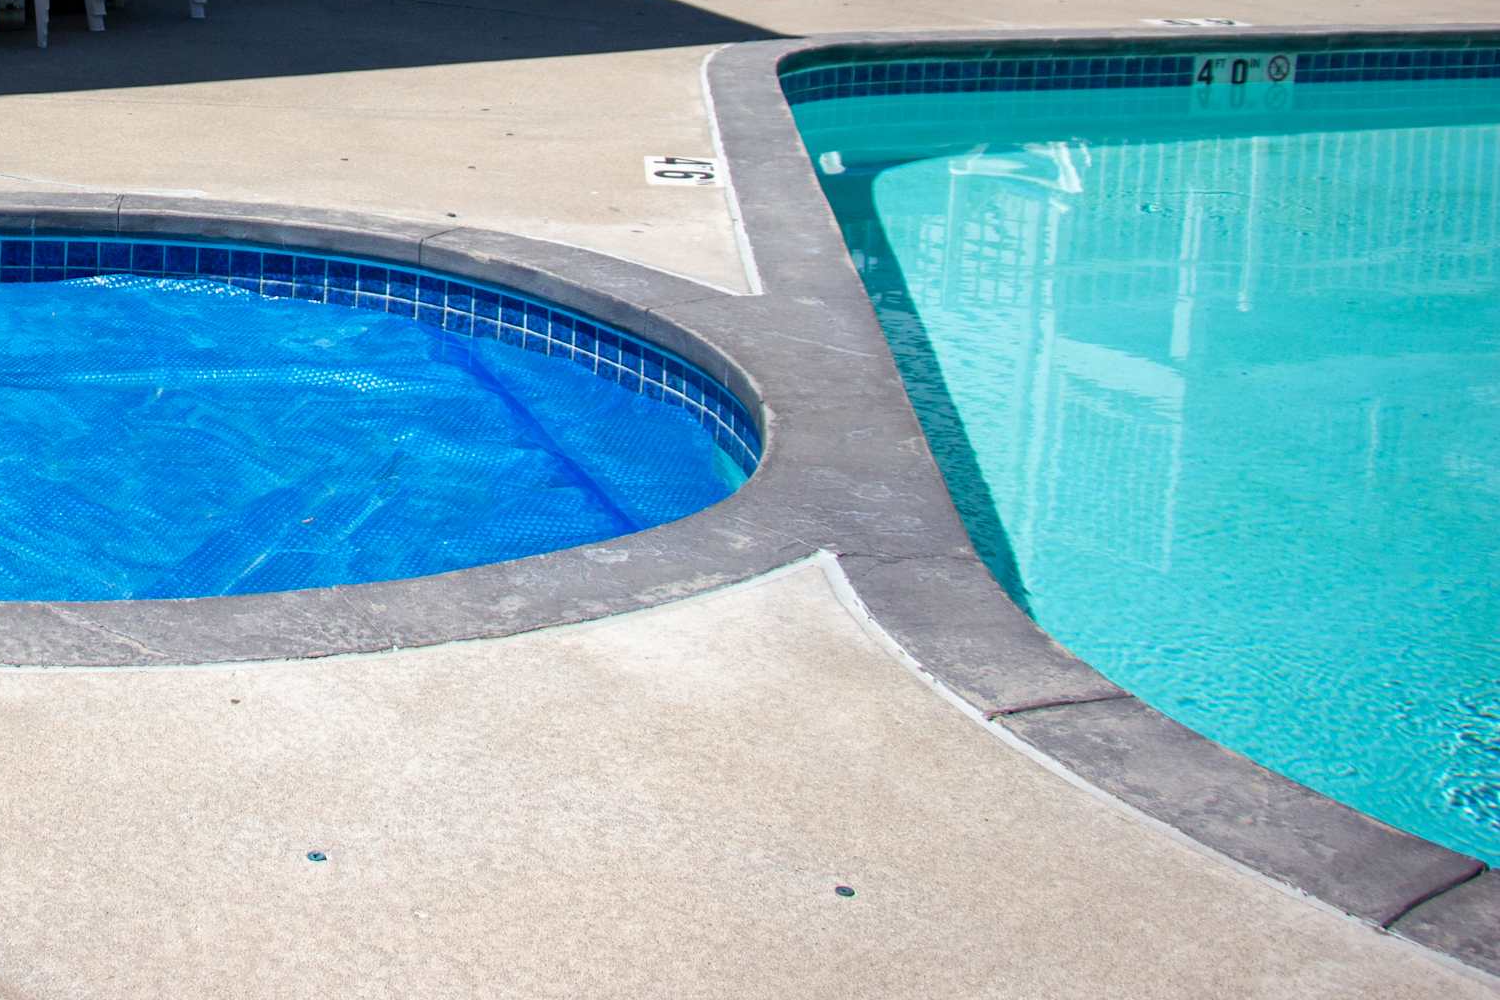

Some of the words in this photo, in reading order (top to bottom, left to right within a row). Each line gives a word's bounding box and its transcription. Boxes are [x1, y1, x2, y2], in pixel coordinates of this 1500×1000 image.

[1197, 58, 1214, 85] 4
[1215, 58, 1226, 69] FT
[1231, 58, 1248, 85] 0
[1250, 57, 1261, 68] IN
[653, 157, 713, 165] 4
[653, 170, 715, 179] 6
